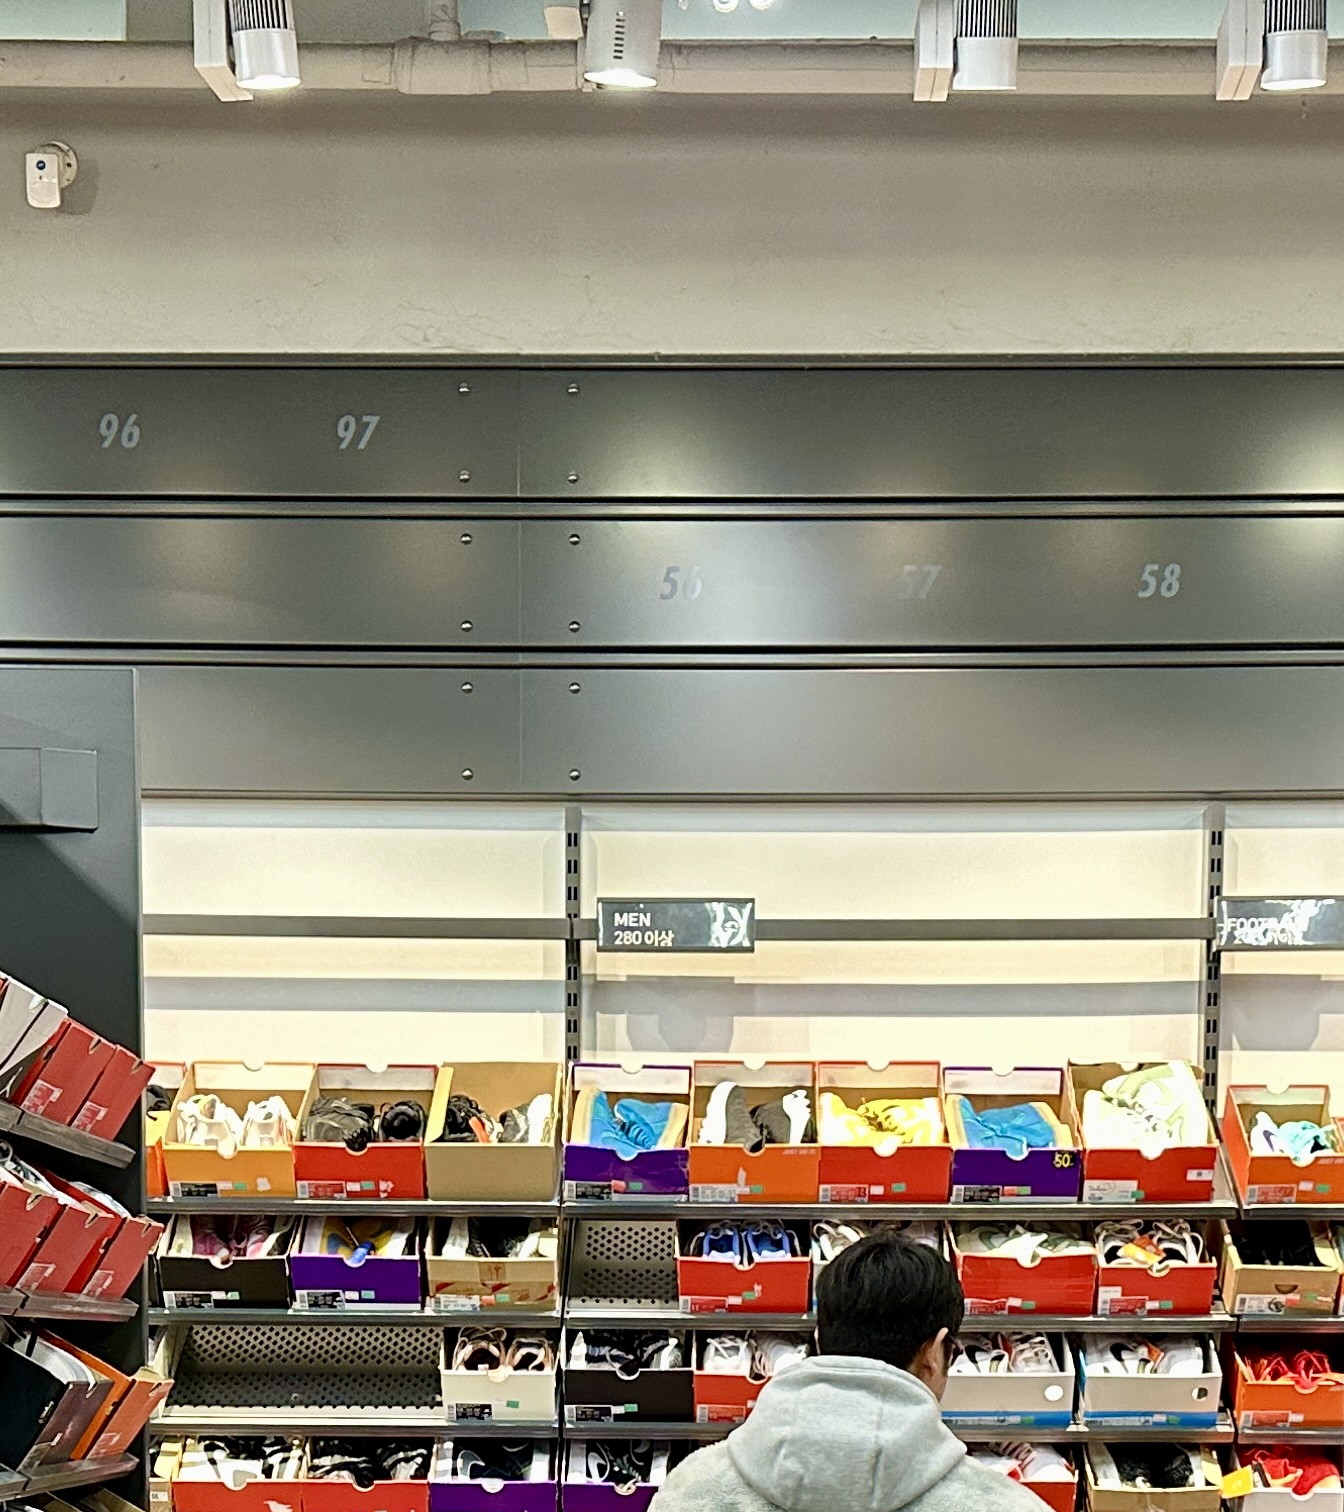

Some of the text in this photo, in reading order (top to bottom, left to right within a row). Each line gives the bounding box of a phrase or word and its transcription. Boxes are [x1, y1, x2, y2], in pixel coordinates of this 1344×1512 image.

[98, 413, 141, 449] 96
[336, 414, 381, 450] 97
[659, 562, 1182, 601] 56 57 58
[613, 912, 652, 927] MEN
[613, 929, 675, 947] 280 이상
